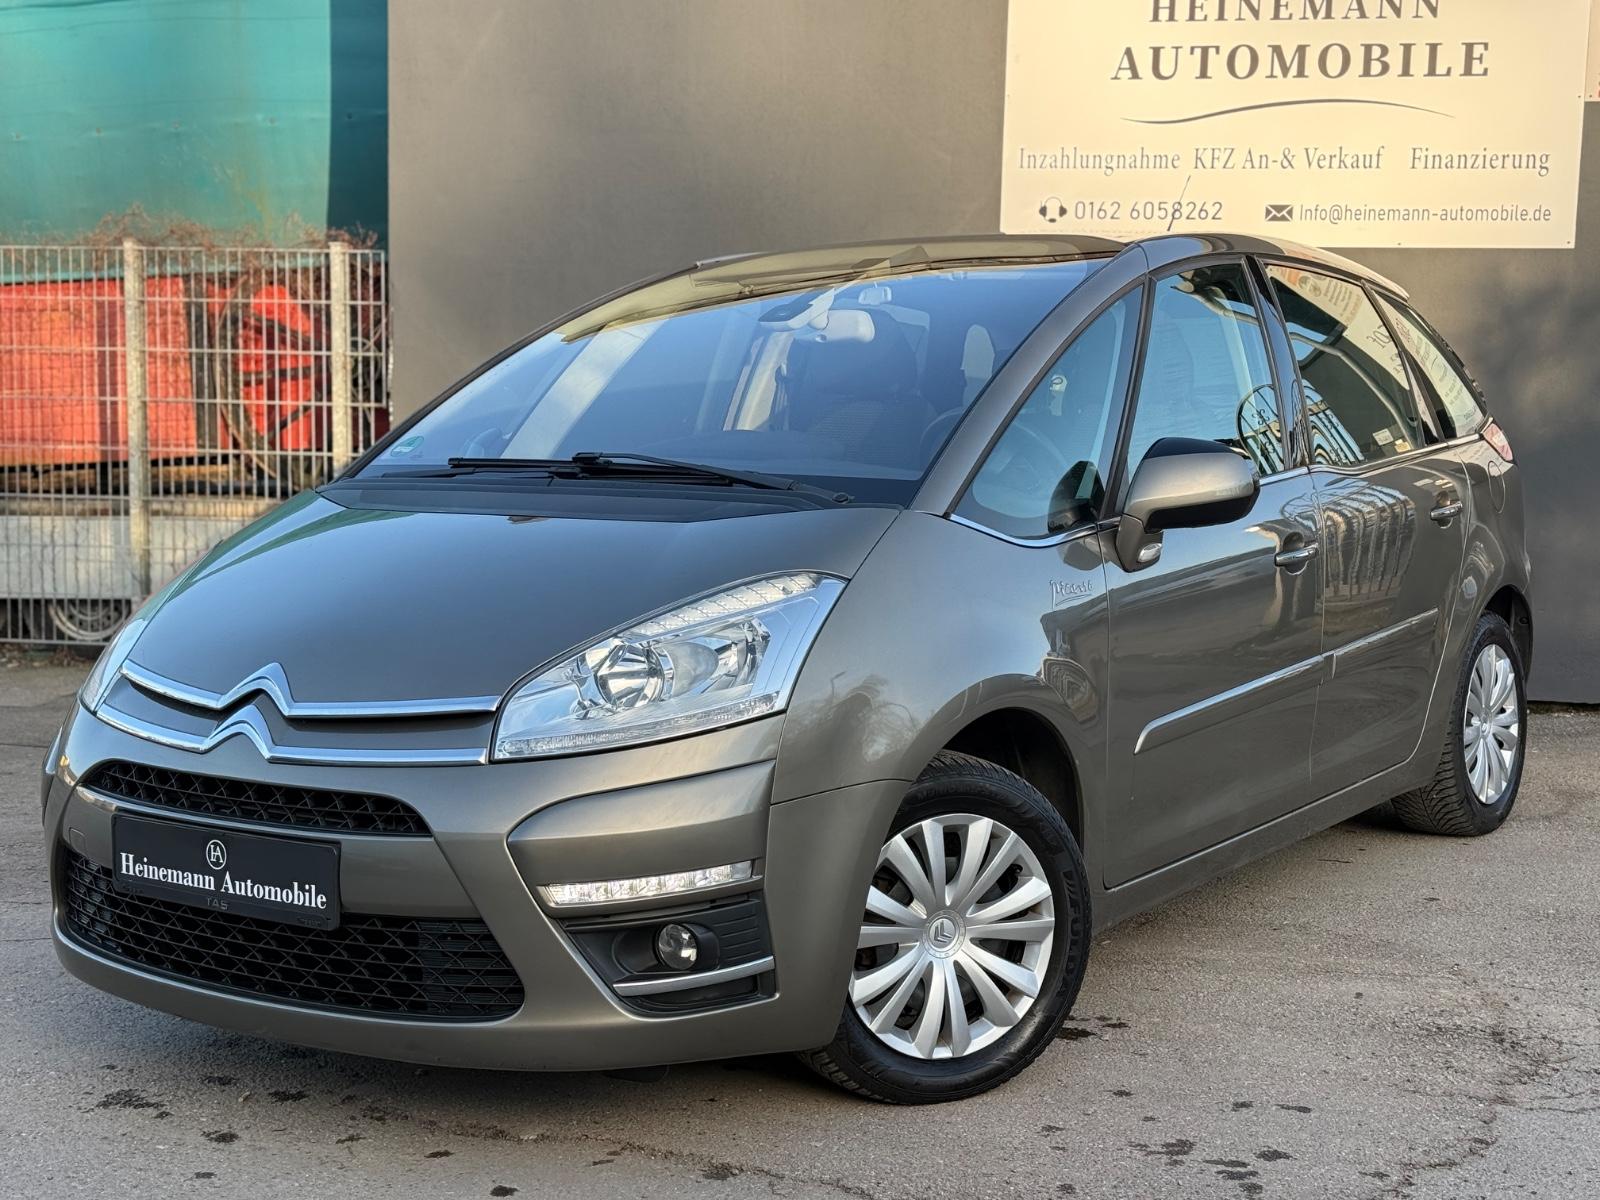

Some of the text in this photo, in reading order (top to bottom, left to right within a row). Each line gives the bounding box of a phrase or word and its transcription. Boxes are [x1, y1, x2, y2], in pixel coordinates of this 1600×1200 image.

[1149, 0, 1440, 22] HEINEMANN
[1111, 42, 1490, 80] AUTOMOBILE
[1019, 147, 1181, 177] Inzahlungnahme
[1193, 147, 1236, 169] KFZ
[1303, 146, 1385, 170] Verkauf
[1409, 147, 1551, 177] Finanzierung
[1074, 201, 1223, 220] 0162 6058262
[1299, 204, 1552, 224] Info@heinemann-automobile.de
[120, 852, 327, 910] Heinemann Automobile
